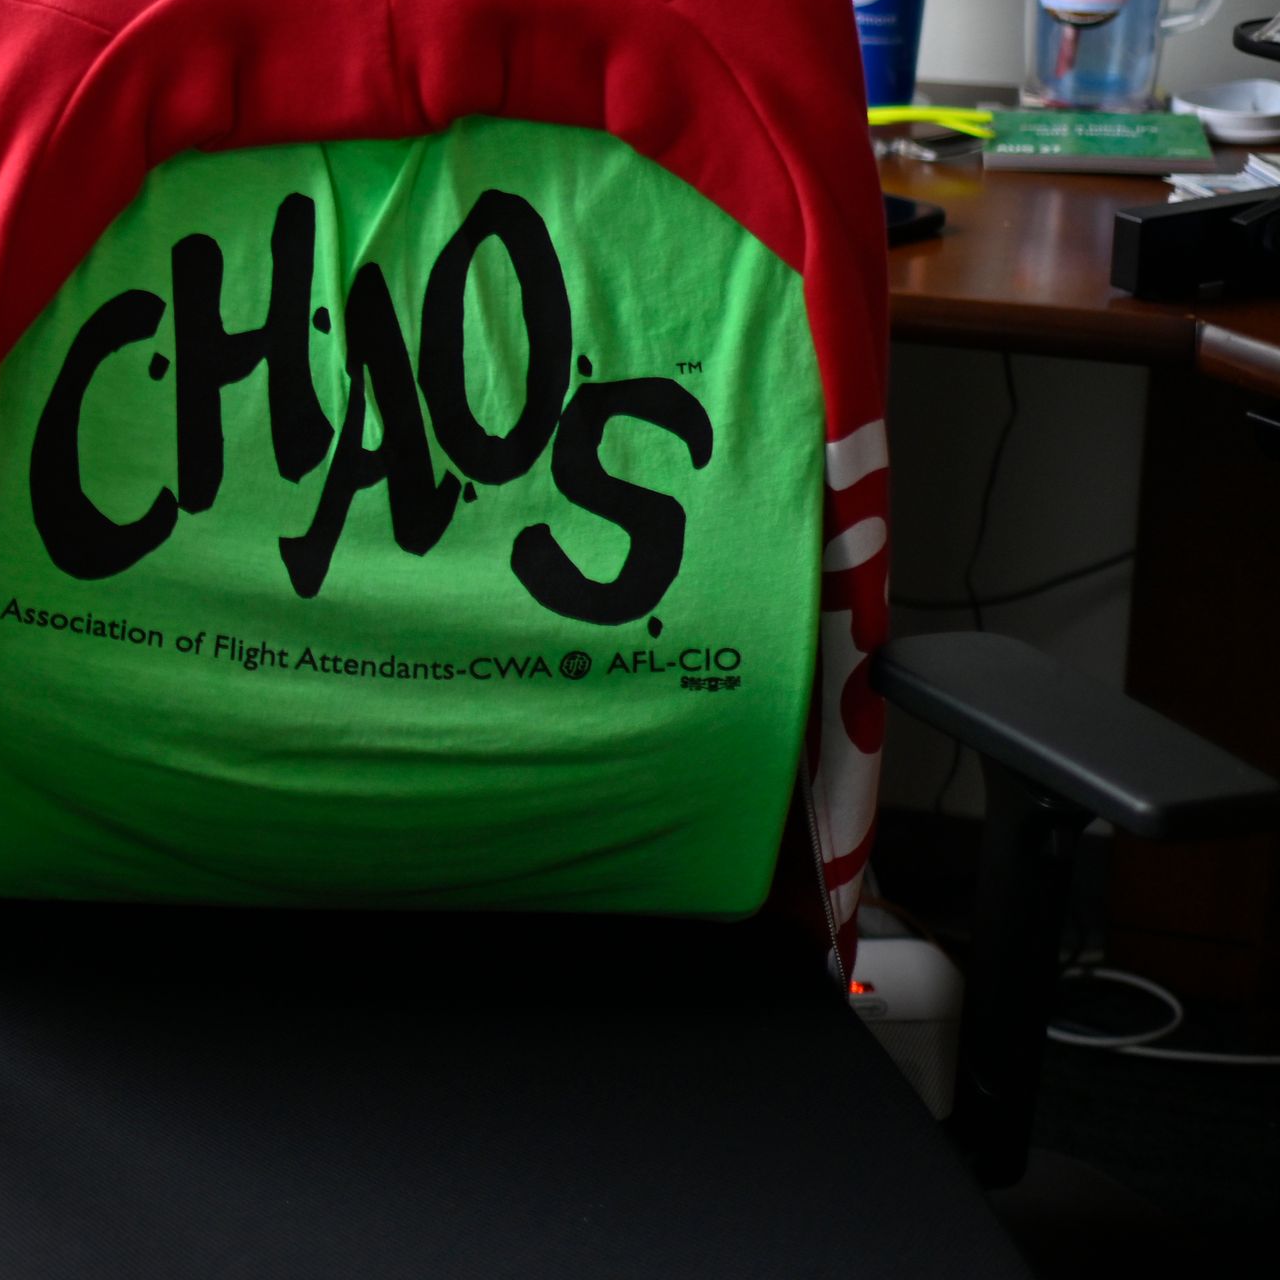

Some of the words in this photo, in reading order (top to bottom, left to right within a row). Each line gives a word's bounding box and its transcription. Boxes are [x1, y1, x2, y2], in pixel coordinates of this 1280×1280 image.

[0, 597, 164, 649] Association
[175, 631, 207, 656] of
[213, 633, 289, 671] Flight
[294, 646, 554, 680] Attendants-CWA
[606, 647, 741, 675] AFL-CIO
